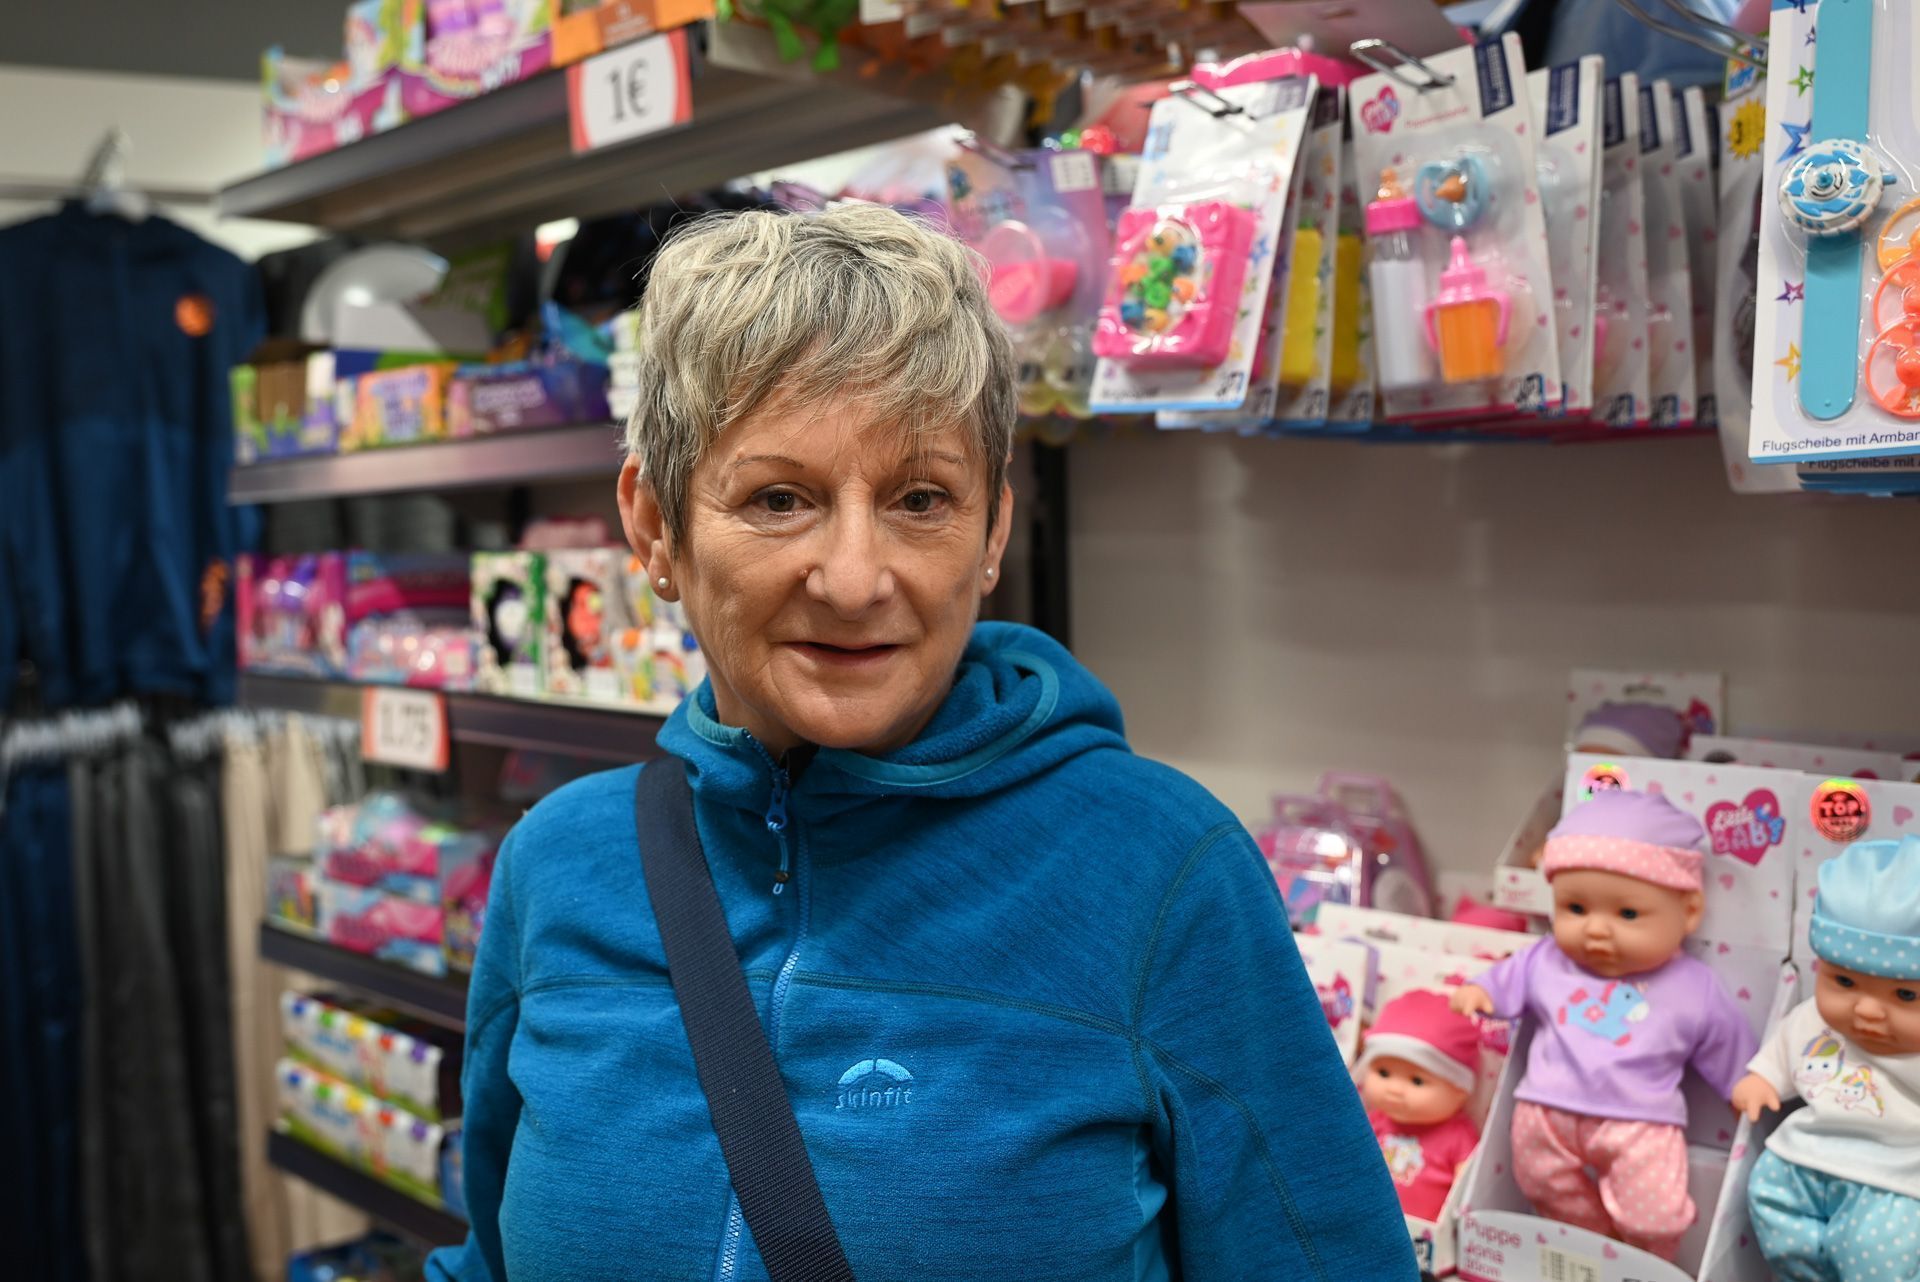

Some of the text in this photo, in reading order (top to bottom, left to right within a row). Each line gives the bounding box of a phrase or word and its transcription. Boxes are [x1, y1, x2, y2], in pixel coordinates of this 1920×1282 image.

[606, 58, 649, 122] 1€
[1762, 436, 1842, 453] Flugscheibe
[1845, 434, 1866, 445] mit
[1808, 455, 1915, 470] Flugscheibe mit
[1464, 1215, 1522, 1248] Puppe
